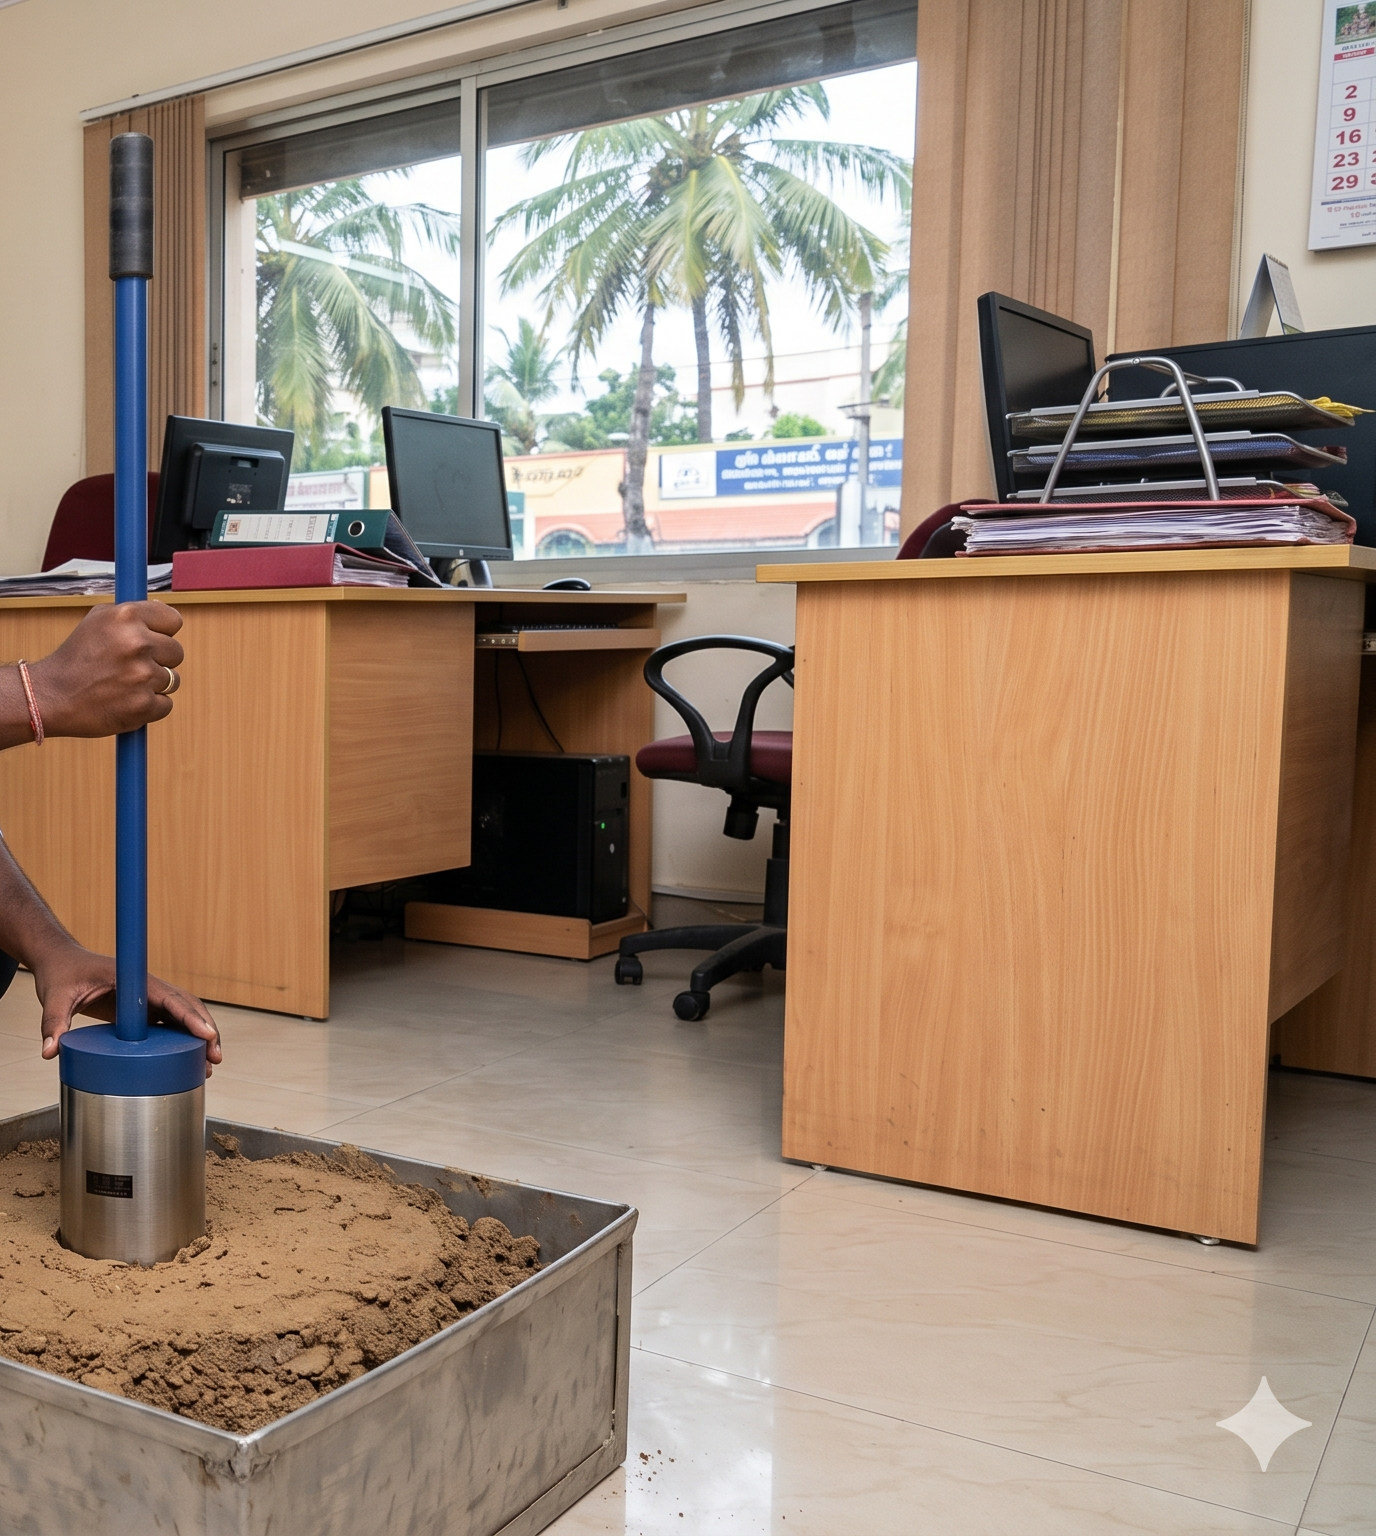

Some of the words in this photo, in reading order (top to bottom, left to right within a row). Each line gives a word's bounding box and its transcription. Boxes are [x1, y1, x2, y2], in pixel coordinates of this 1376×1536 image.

[1345, 85, 1357, 99] 2
[1343, 107, 1356, 122] 9
[1336, 129, 1361, 145] 16
[1333, 152, 1359, 168] 23
[1331, 174, 1359, 191] 29
